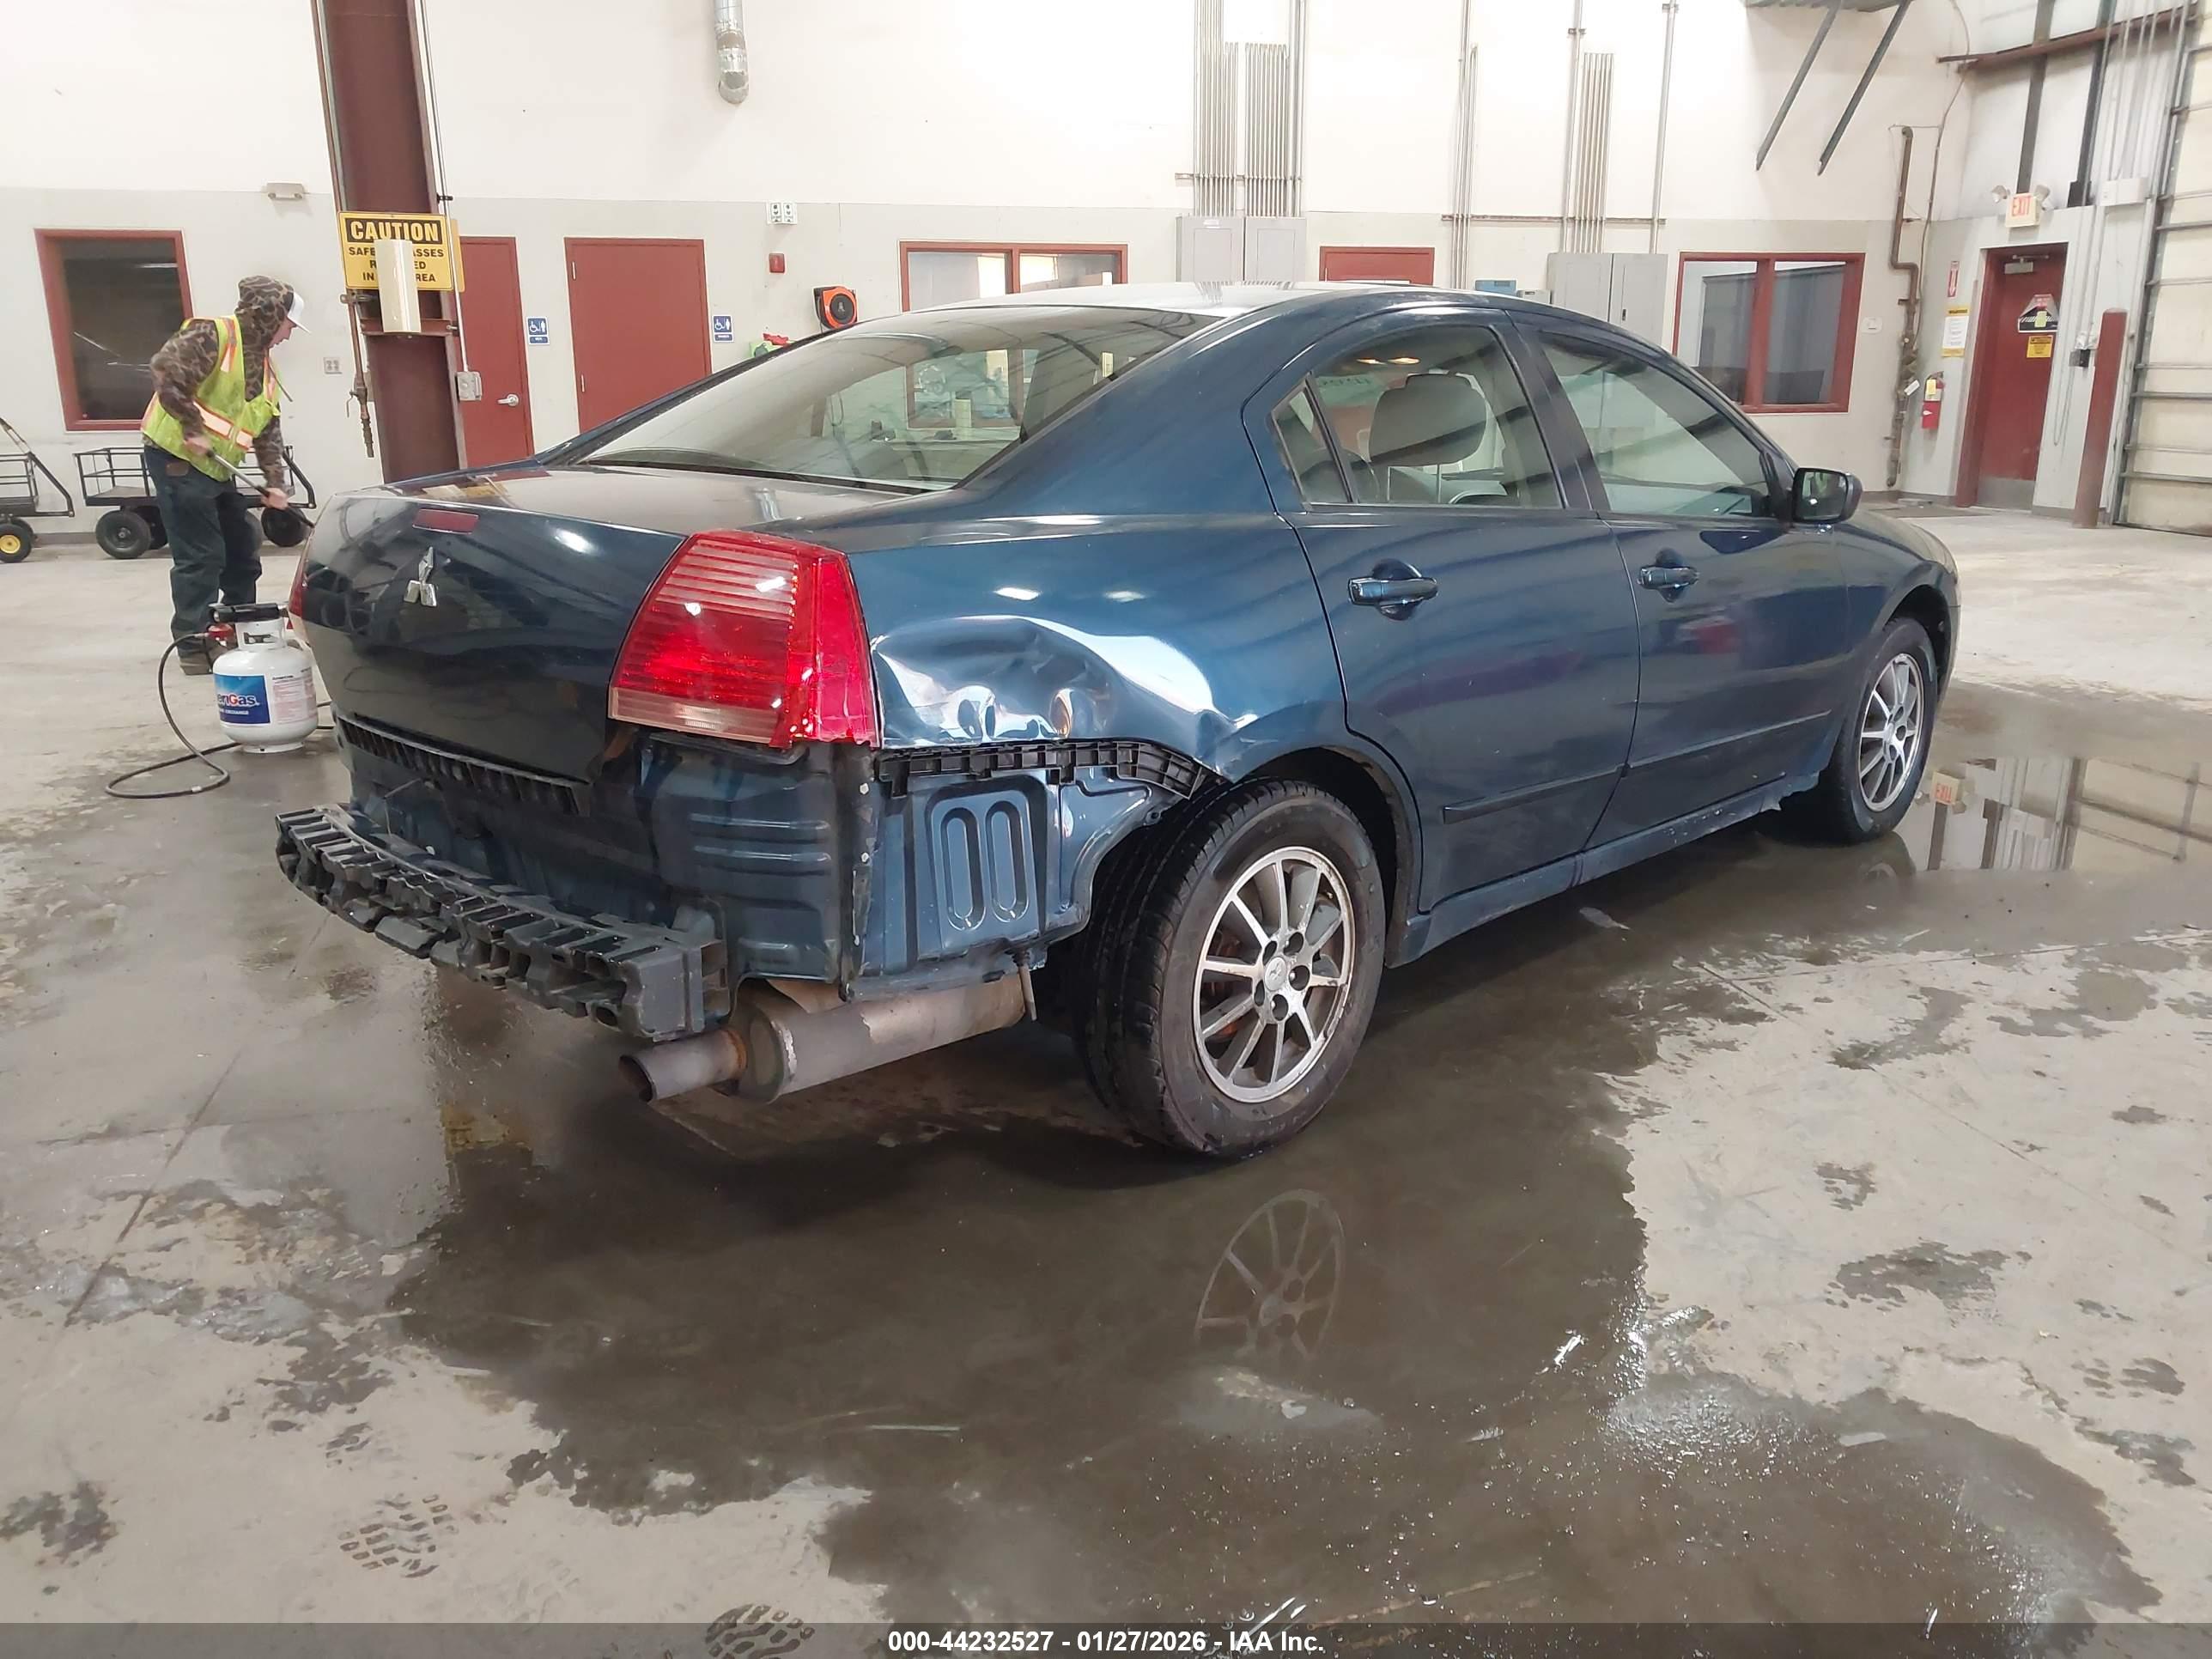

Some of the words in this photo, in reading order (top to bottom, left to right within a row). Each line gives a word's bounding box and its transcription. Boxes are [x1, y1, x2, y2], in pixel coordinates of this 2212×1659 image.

[350, 221, 439, 241] CAUTION
[349, 246, 375, 256] SAFE
[413, 248, 444, 258] SSES
[362, 272, 374, 281] IN
[416, 274, 436, 283] REA
